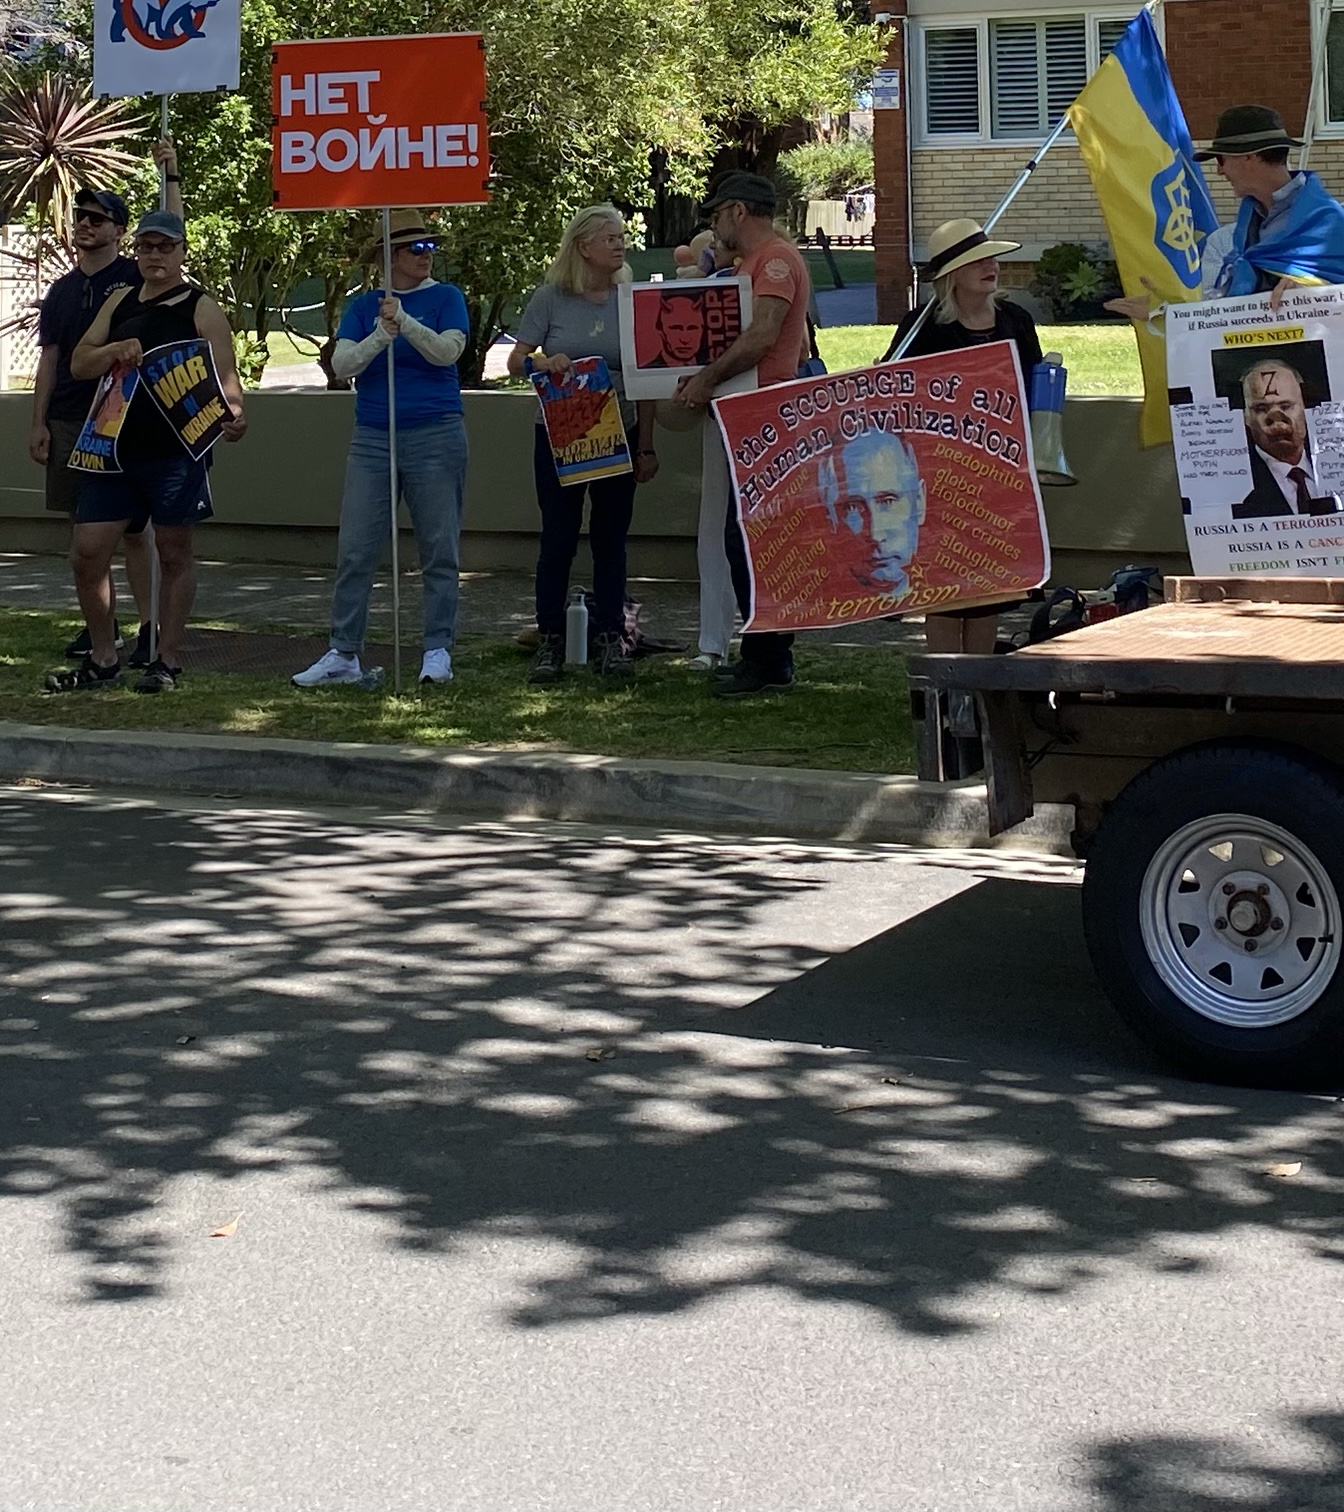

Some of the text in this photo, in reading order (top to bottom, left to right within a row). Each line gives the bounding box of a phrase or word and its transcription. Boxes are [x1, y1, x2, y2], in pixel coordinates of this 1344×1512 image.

[280, 70, 381, 117] НЕТ
[280, 113, 480, 174] ВОЙНЕ!
[723, 289, 739, 348] UTIN
[1172, 310, 1191, 320] You
[1192, 306, 1221, 320] might
[1222, 304, 1246, 314] want
[1248, 302, 1257, 311] to
[1259, 298, 1290, 313] igre
[1292, 295, 1312, 306] this
[1188, 321, 1196, 331] if
[1197, 319, 1229, 330] Russia
[1230, 314, 1274, 326] succeeds
[1275, 312, 1285, 322] in
[1286, 309, 1330, 321] Ukraine
[1224, 329, 1304, 345] WHO'S NEXT?
[146, 345, 199, 383] STOP
[153, 355, 208, 409] WAR
[1260, 371, 1280, 397] Z
[181, 396, 226, 446] UKRAINE
[182, 395, 200, 417] IN
[736, 370, 1018, 468] the SCOURGE of all
[77, 435, 112, 457] KRAINE
[81, 452, 105, 471] WIN
[739, 402, 1023, 514] Human Civilization
[933, 442, 1026, 492] paedophilia
[934, 468, 984, 499] global
[930, 481, 1016, 532] Holodomor
[756, 507, 807, 573] abduction
[941, 510, 1022, 561] war crimes
[1194, 524, 1239, 537] RUSSIA
[1242, 522, 1255, 533] IS
[1259, 522, 1270, 532] A
[1227, 541, 1273, 554] RUSSIA
[1277, 540, 1290, 550] IS
[1294, 539, 1305, 549] A
[939, 534, 1011, 579] slaughter
[1228, 560, 1291, 572] FREEDOM
[1295, 557, 1329, 569] ISN'T
[826, 582, 961, 620] terrorism
